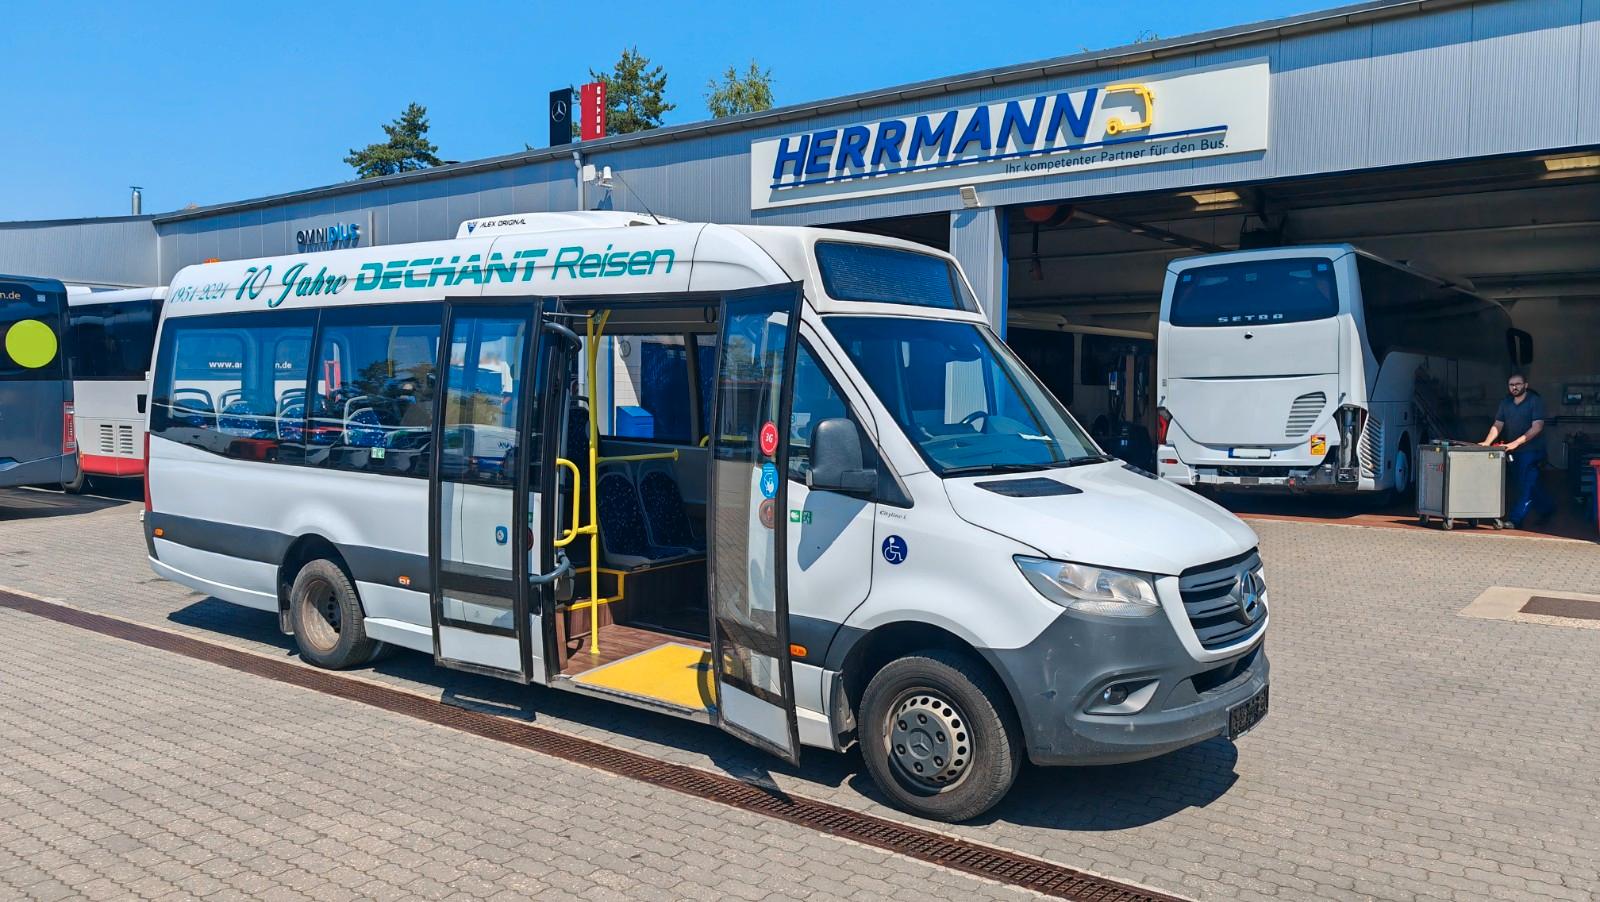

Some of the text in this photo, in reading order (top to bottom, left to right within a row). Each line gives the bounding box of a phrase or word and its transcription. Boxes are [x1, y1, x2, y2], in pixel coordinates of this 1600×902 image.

[772, 88, 1099, 180] HERRMANN
[1005, 138, 1229, 174] Ihr kompetenter Partner für den Bus.
[235, 264, 273, 301] 70
[268, 261, 348, 309] Jahre
[353, 247, 549, 292] DECHANT
[552, 243, 675, 281] Reisen
[1217, 313, 1284, 323] SETRA
